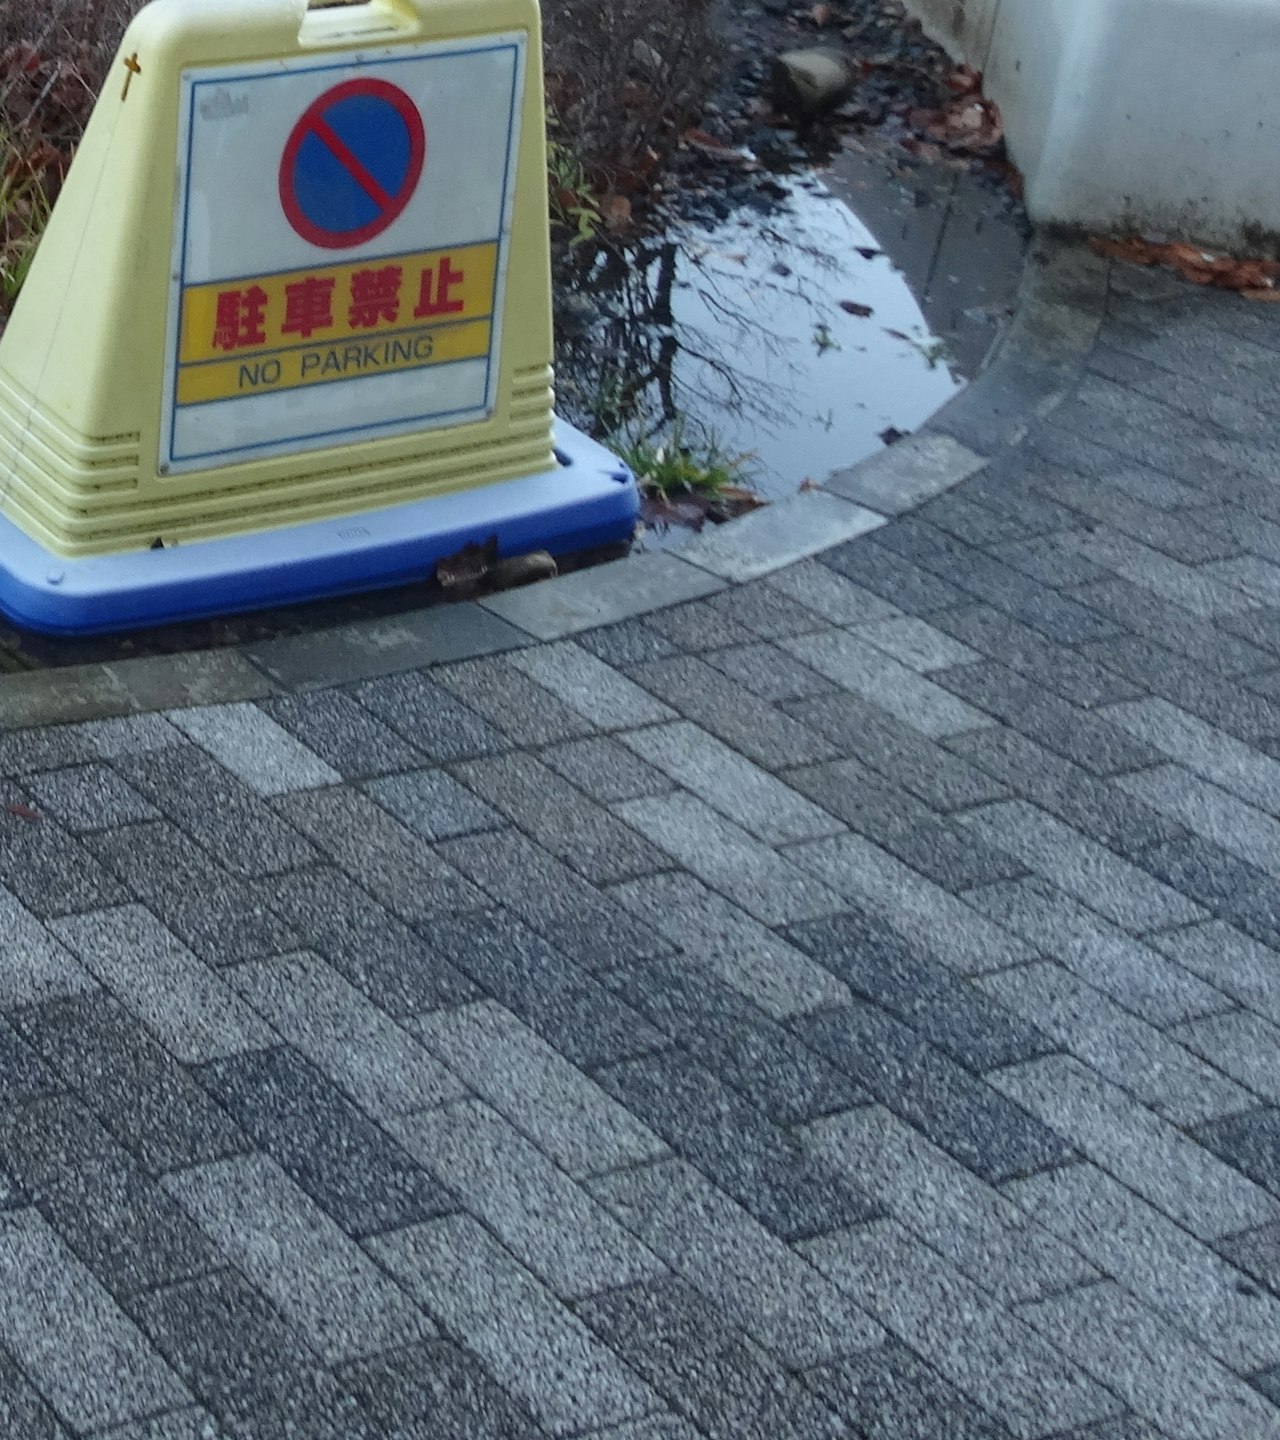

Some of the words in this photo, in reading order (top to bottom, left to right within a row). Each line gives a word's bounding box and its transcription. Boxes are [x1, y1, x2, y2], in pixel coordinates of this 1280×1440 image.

[212, 256, 465, 352] 駐車禁止
[237, 358, 282, 389] NO
[299, 334, 435, 378] PARKING
